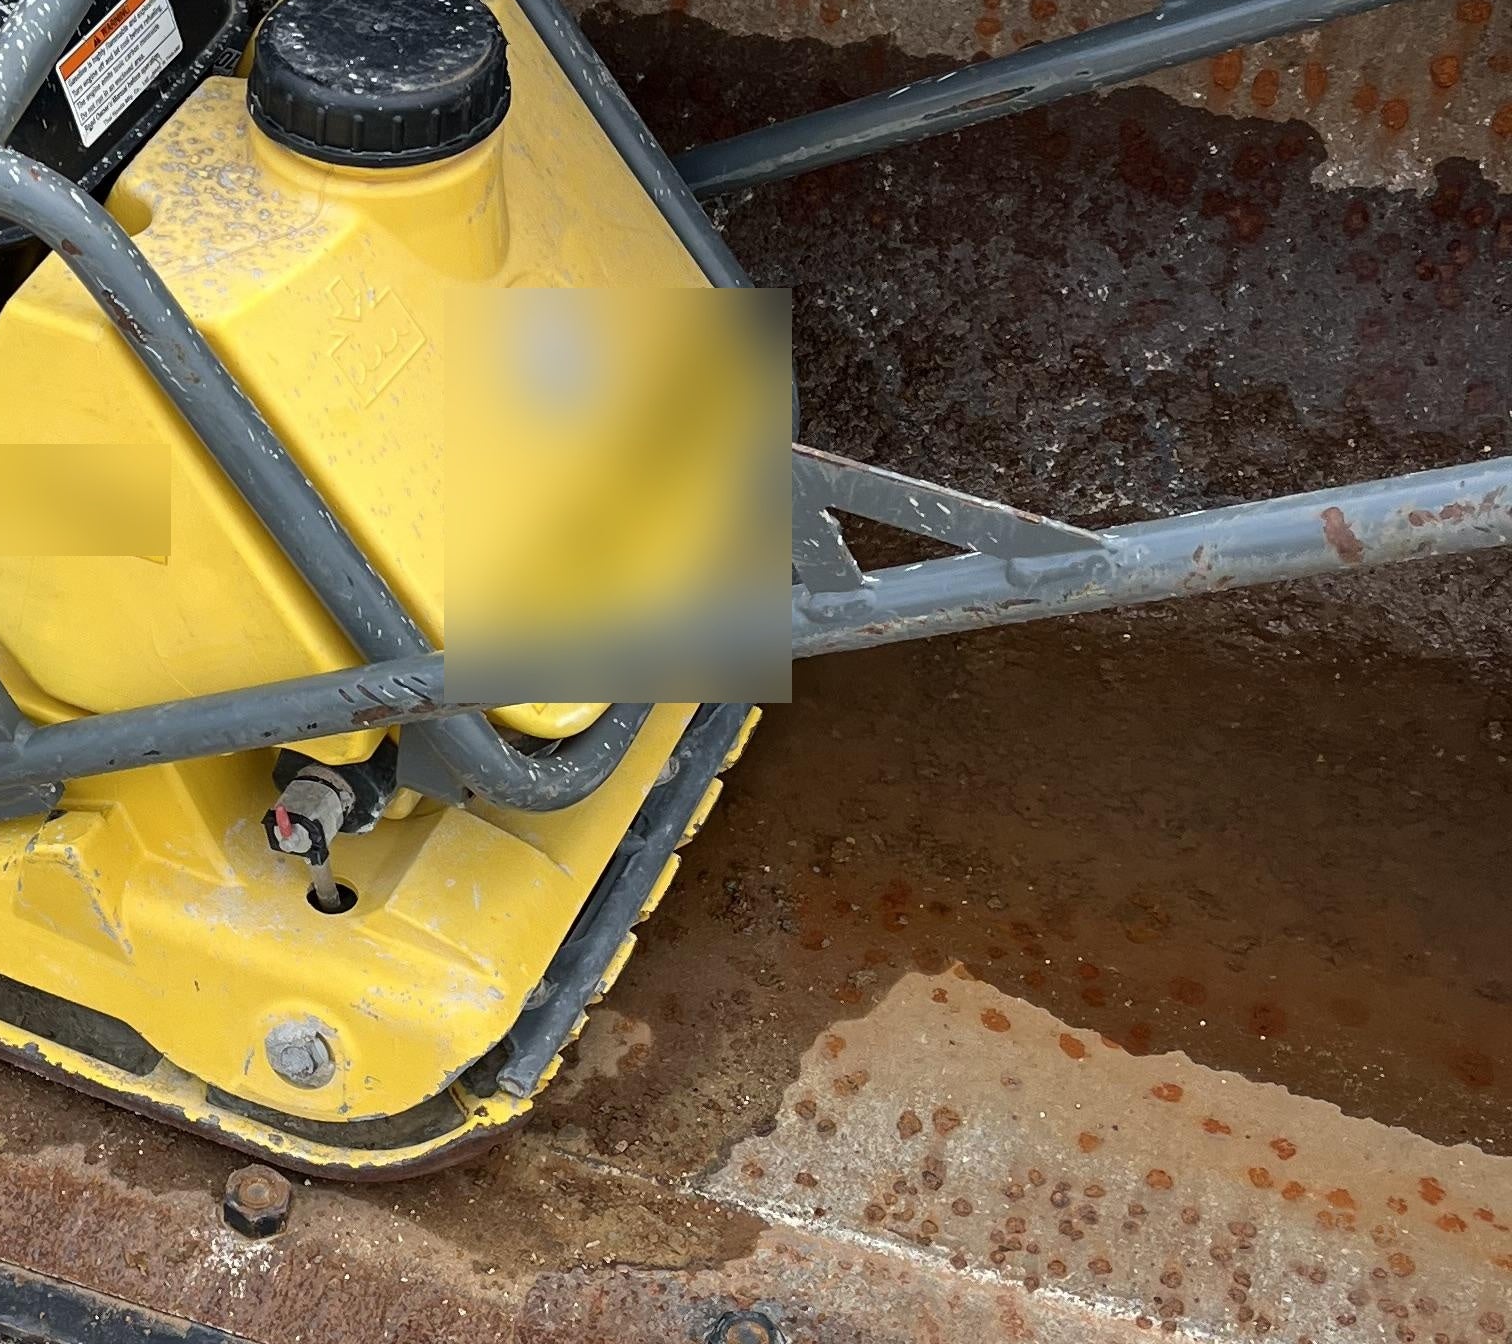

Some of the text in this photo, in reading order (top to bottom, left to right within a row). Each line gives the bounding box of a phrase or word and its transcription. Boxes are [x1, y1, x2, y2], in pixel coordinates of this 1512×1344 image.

[100, 3, 130, 38] WARNING
[82, 67, 98, 89] engine
[104, 51, 113, 65] and
[86, 82, 101, 103] engine
